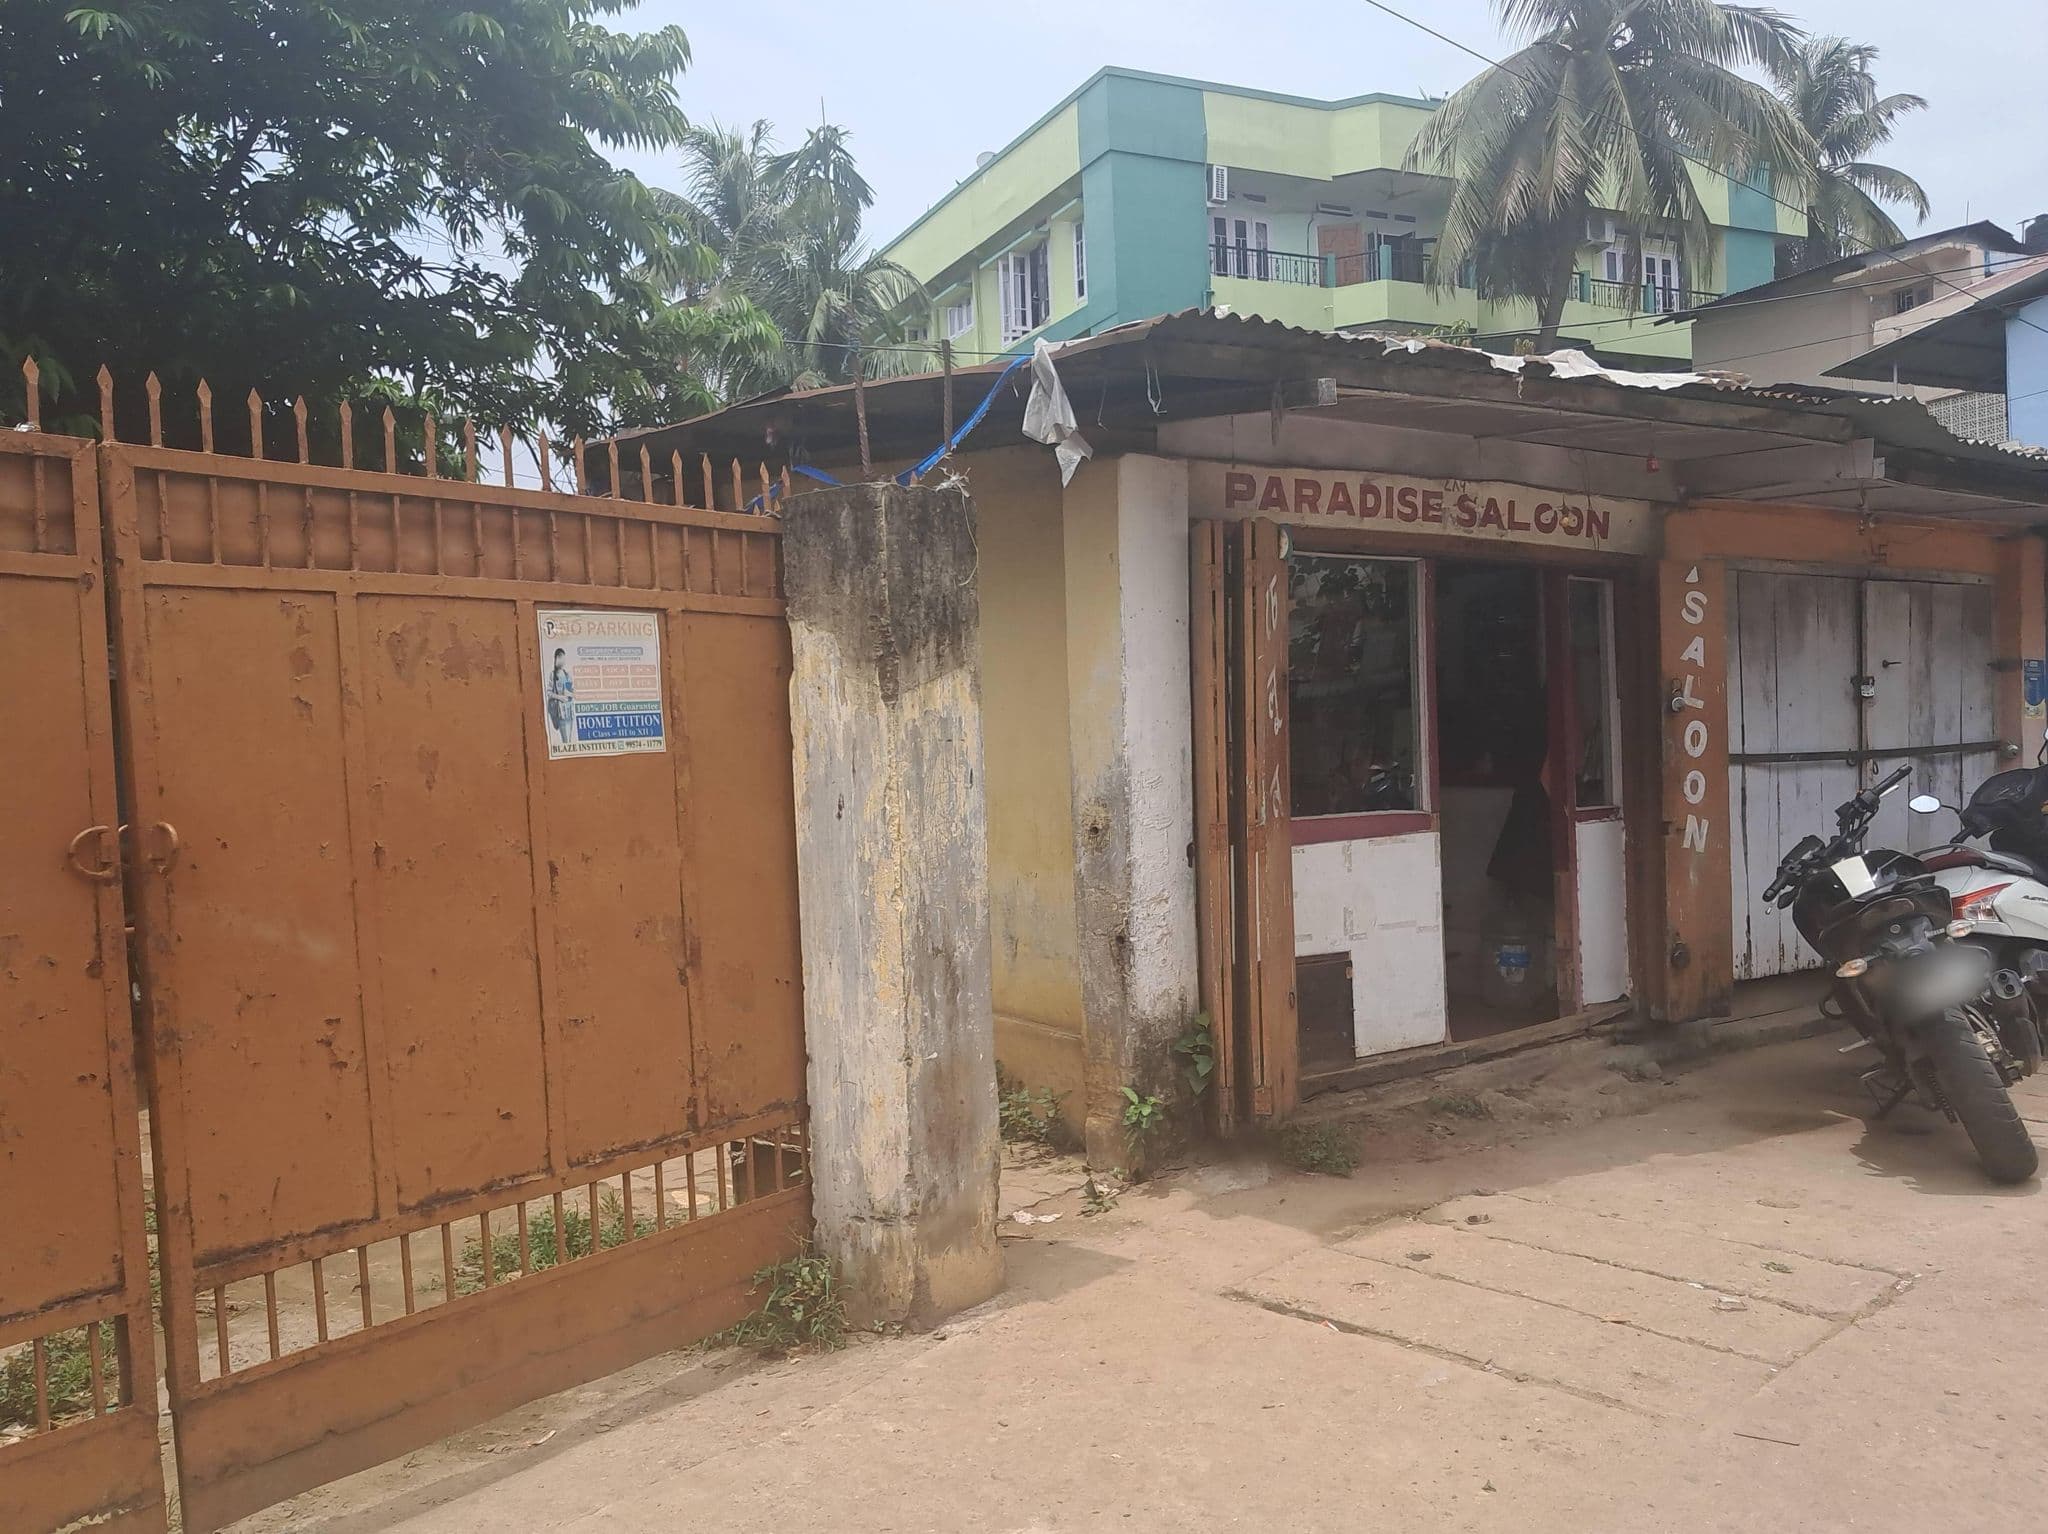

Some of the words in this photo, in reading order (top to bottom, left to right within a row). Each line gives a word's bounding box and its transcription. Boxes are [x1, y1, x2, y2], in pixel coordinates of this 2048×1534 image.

[1225, 471, 1444, 523] PARADISE
[1456, 493, 1611, 541] SALOON
[587, 622, 653, 637] PARKING
[577, 703, 599, 712] 100%
[600, 703, 618, 712] JOB
[620, 702, 659, 711] Guarantee
[578, 717, 612, 729] HOME
[615, 714, 660, 727] TUITION
[1679, 590, 1710, 853] SALOON
[592, 730, 611, 738] Class
[629, 728, 637, 736] to
[552, 744, 577, 753] BLAZE
[579, 741, 617, 752] INSTITUTE
